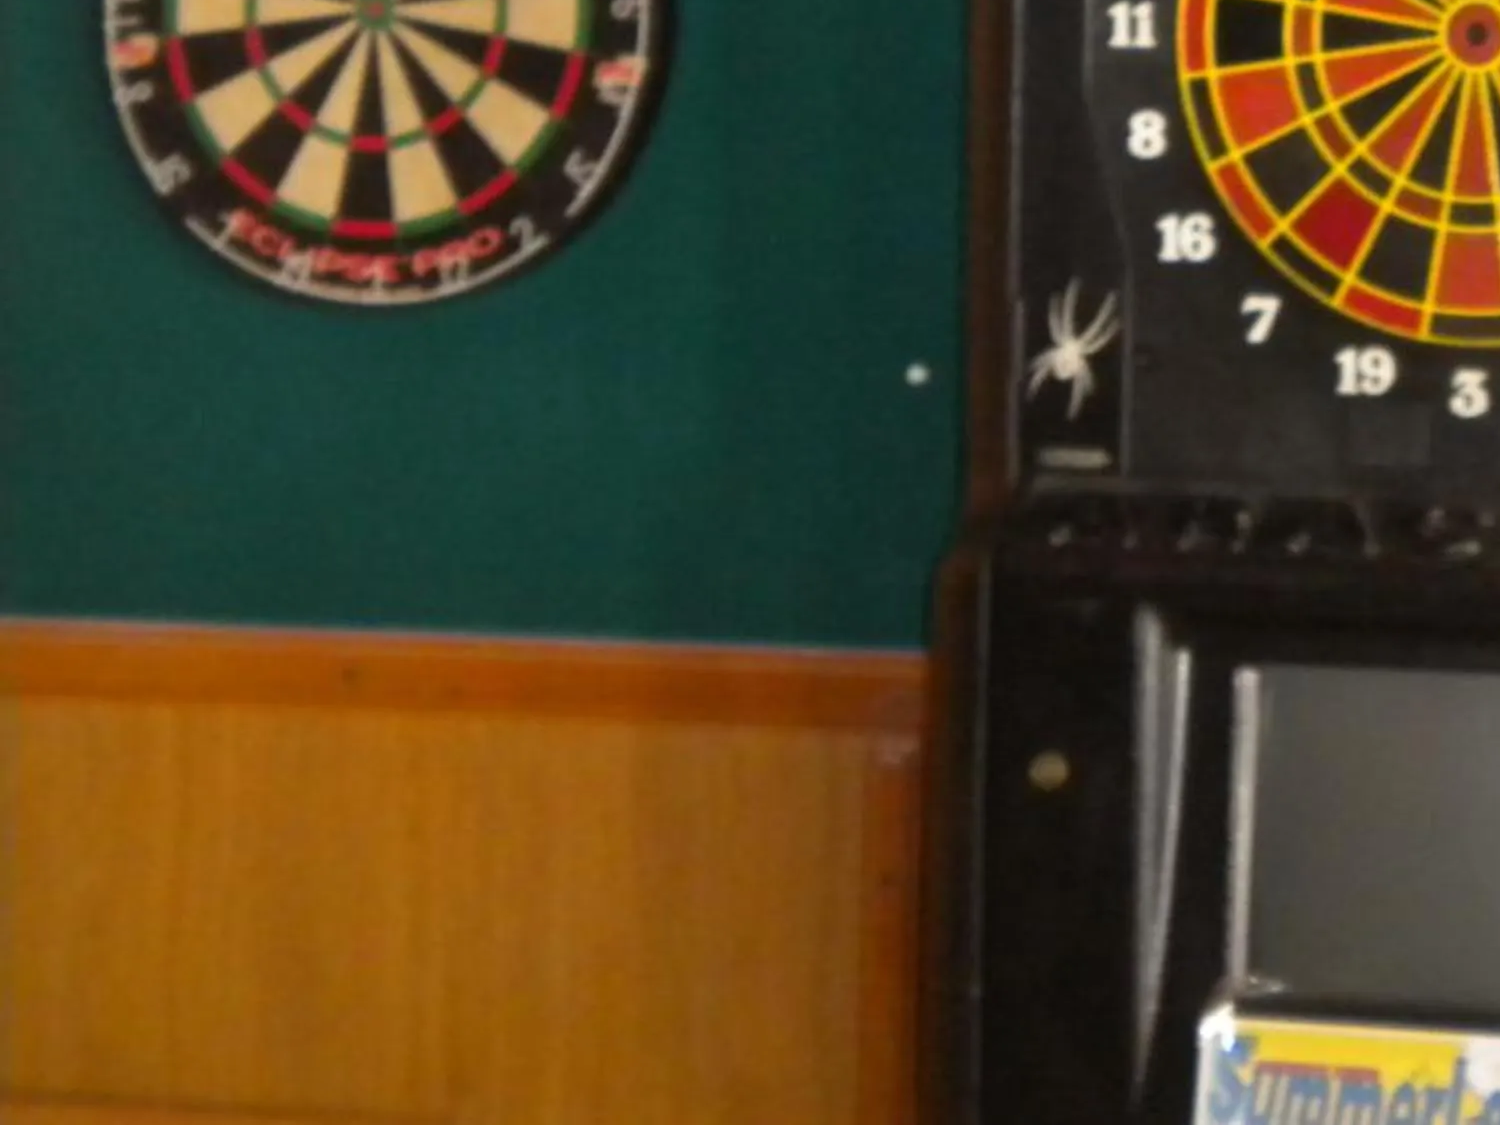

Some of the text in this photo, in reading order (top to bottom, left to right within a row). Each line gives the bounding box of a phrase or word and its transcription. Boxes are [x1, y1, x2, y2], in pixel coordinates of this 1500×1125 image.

[1105, 0, 1158, 51] 11
[1126, 107, 1169, 161] 8
[1155, 211, 1218, 264] 16
[1240, 293, 1282, 345] 7
[1334, 345, 1398, 397] 19
[1448, 367, 1491, 420] 3
